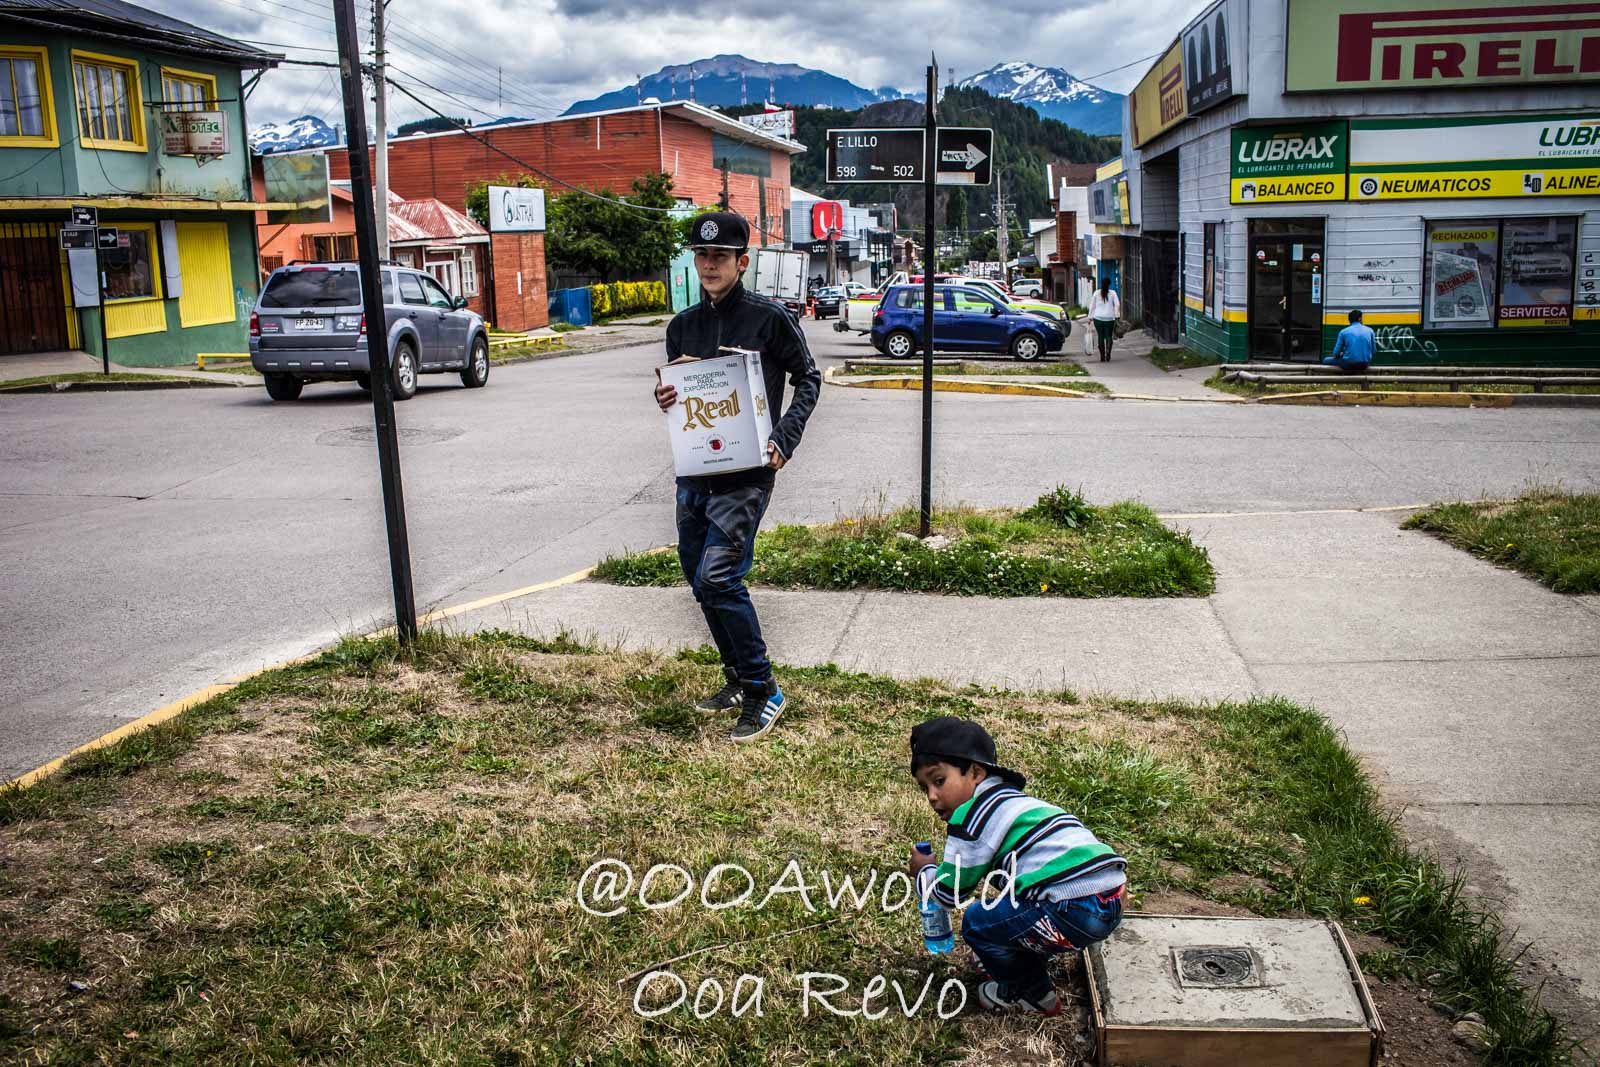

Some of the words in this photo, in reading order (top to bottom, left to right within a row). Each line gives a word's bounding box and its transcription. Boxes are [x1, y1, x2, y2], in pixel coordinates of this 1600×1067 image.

[1238, 135, 1338, 163] LUBRAX
[1548, 148, 1589, 156] LUBRICANTE
[836, 166, 857, 177] 598
[893, 165, 914, 177] 502
[1247, 164, 1284, 173] LUBRICANTE
[1296, 161, 1335, 170] PETROBRAS
[1258, 181, 1335, 196] BALANCEO
[1381, 178, 1492, 193] NEUMATICOS
[1545, 175, 1600, 190] ALINE
[1432, 231, 1488, 241] RECHAZADO
[1500, 306, 1568, 318] SERVITECA
[683, 370, 727, 382] MERCADERIA
[683, 380, 729, 393] EXPORTACION
[679, 388, 741, 432] Real
